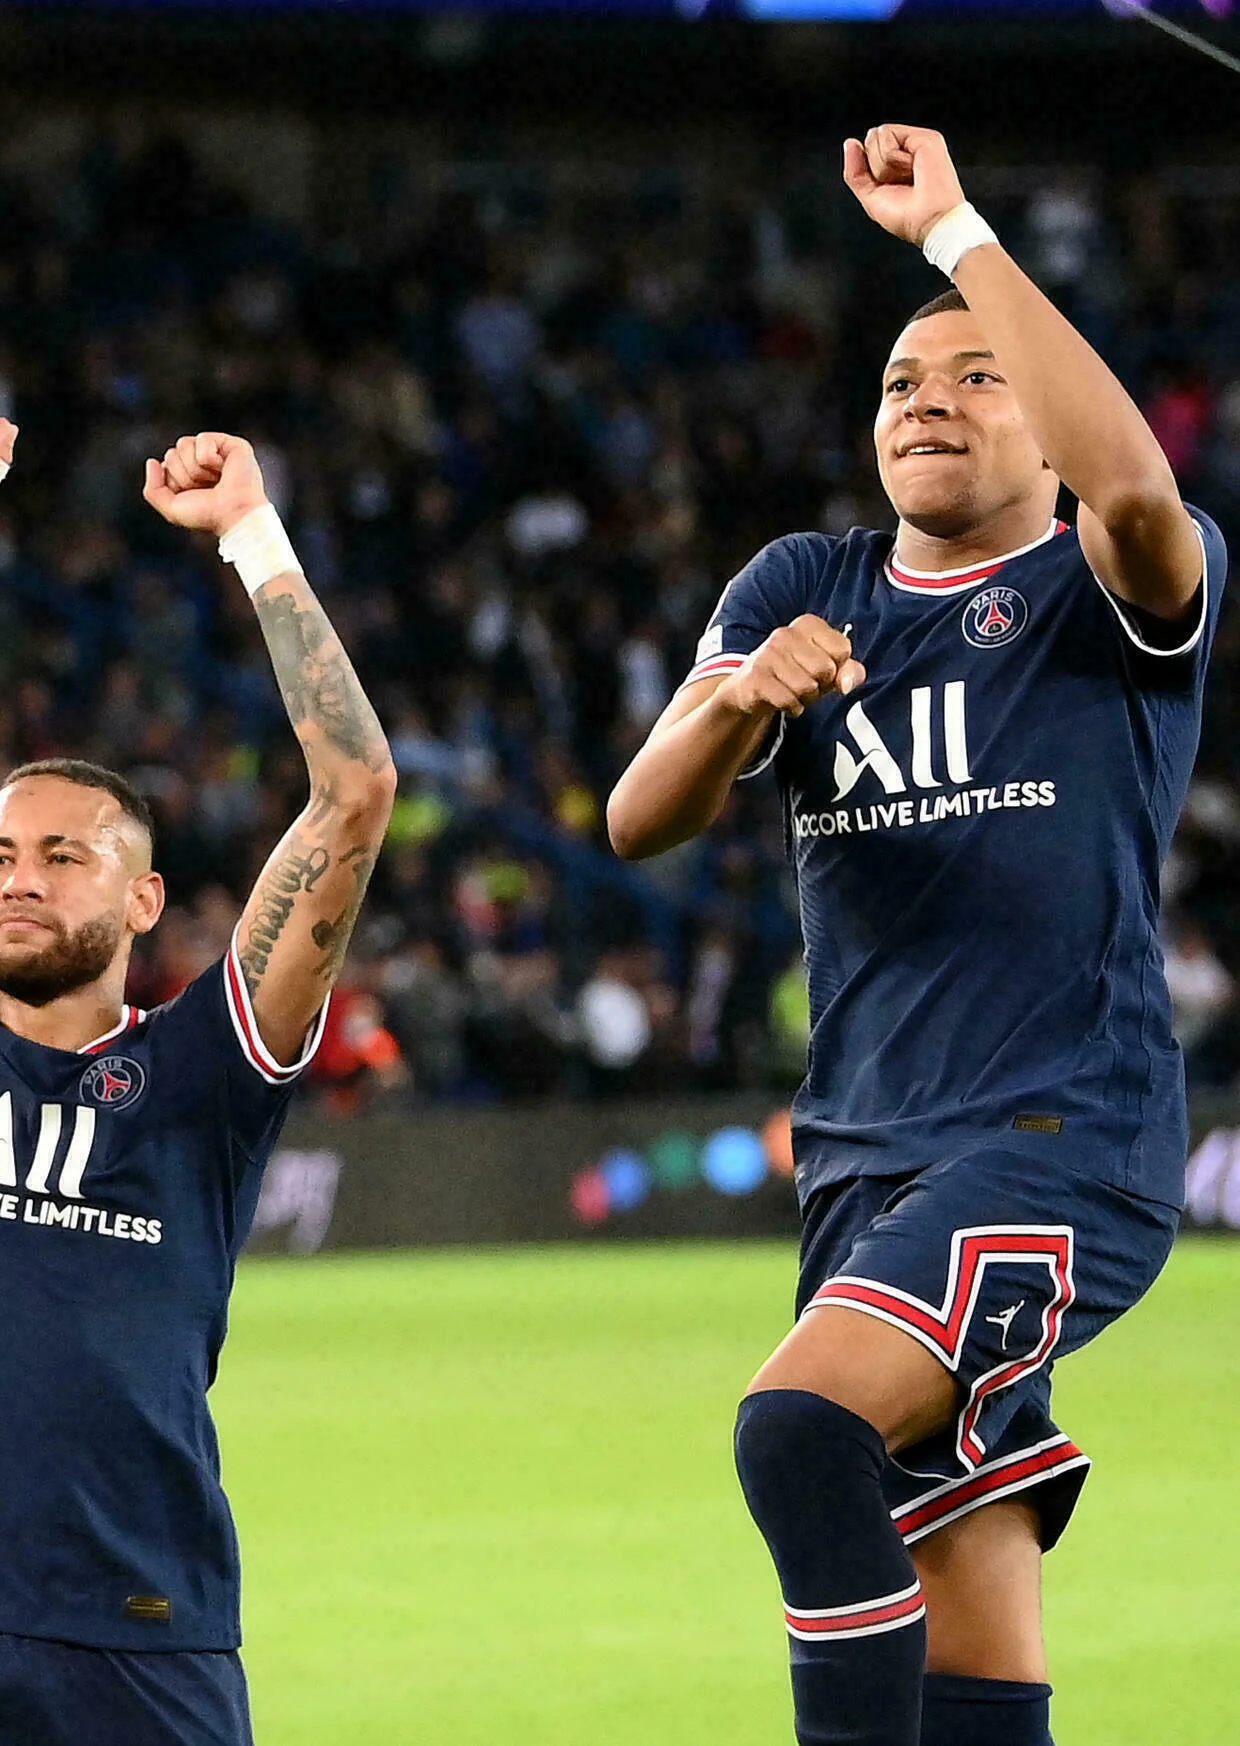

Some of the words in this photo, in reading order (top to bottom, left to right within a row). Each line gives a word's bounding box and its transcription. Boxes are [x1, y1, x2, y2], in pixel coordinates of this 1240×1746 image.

[972, 590, 1015, 611] PARIS
[855, 801, 915, 832] LIVE
[919, 781, 1056, 823] LIMITLESS
[84, 1059, 123, 1085] PARIS
[23, 1198, 162, 1244] LIMITLESS
